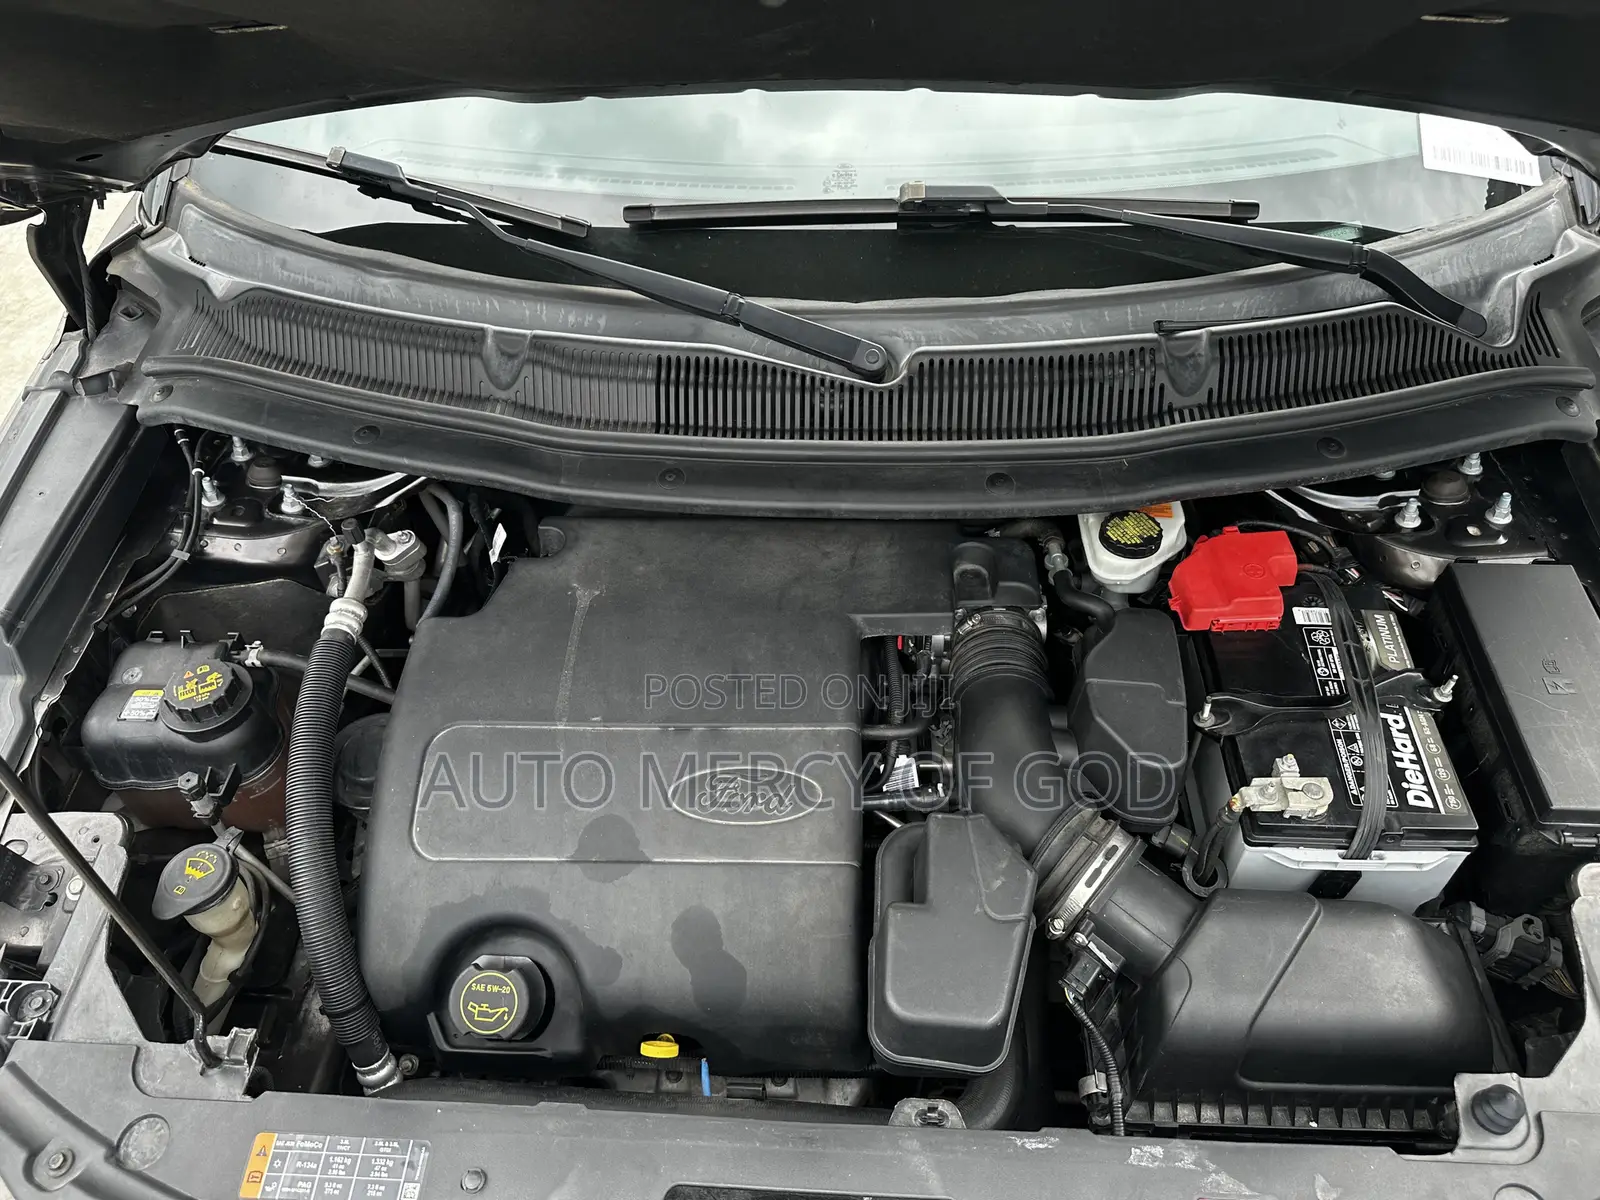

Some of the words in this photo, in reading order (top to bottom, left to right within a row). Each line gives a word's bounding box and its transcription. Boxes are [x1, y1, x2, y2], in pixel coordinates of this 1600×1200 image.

[1373, 614, 1401, 664] PLATINUM
[1379, 711, 1435, 809] DieHard
[697, 774, 797, 815] Ford
[471, 983, 485, 991] SAE
[486, 984, 510, 993] 5W-20
[296, 1140, 323, 1149] FoMoCo
[296, 1160, 318, 1169] R-134a
